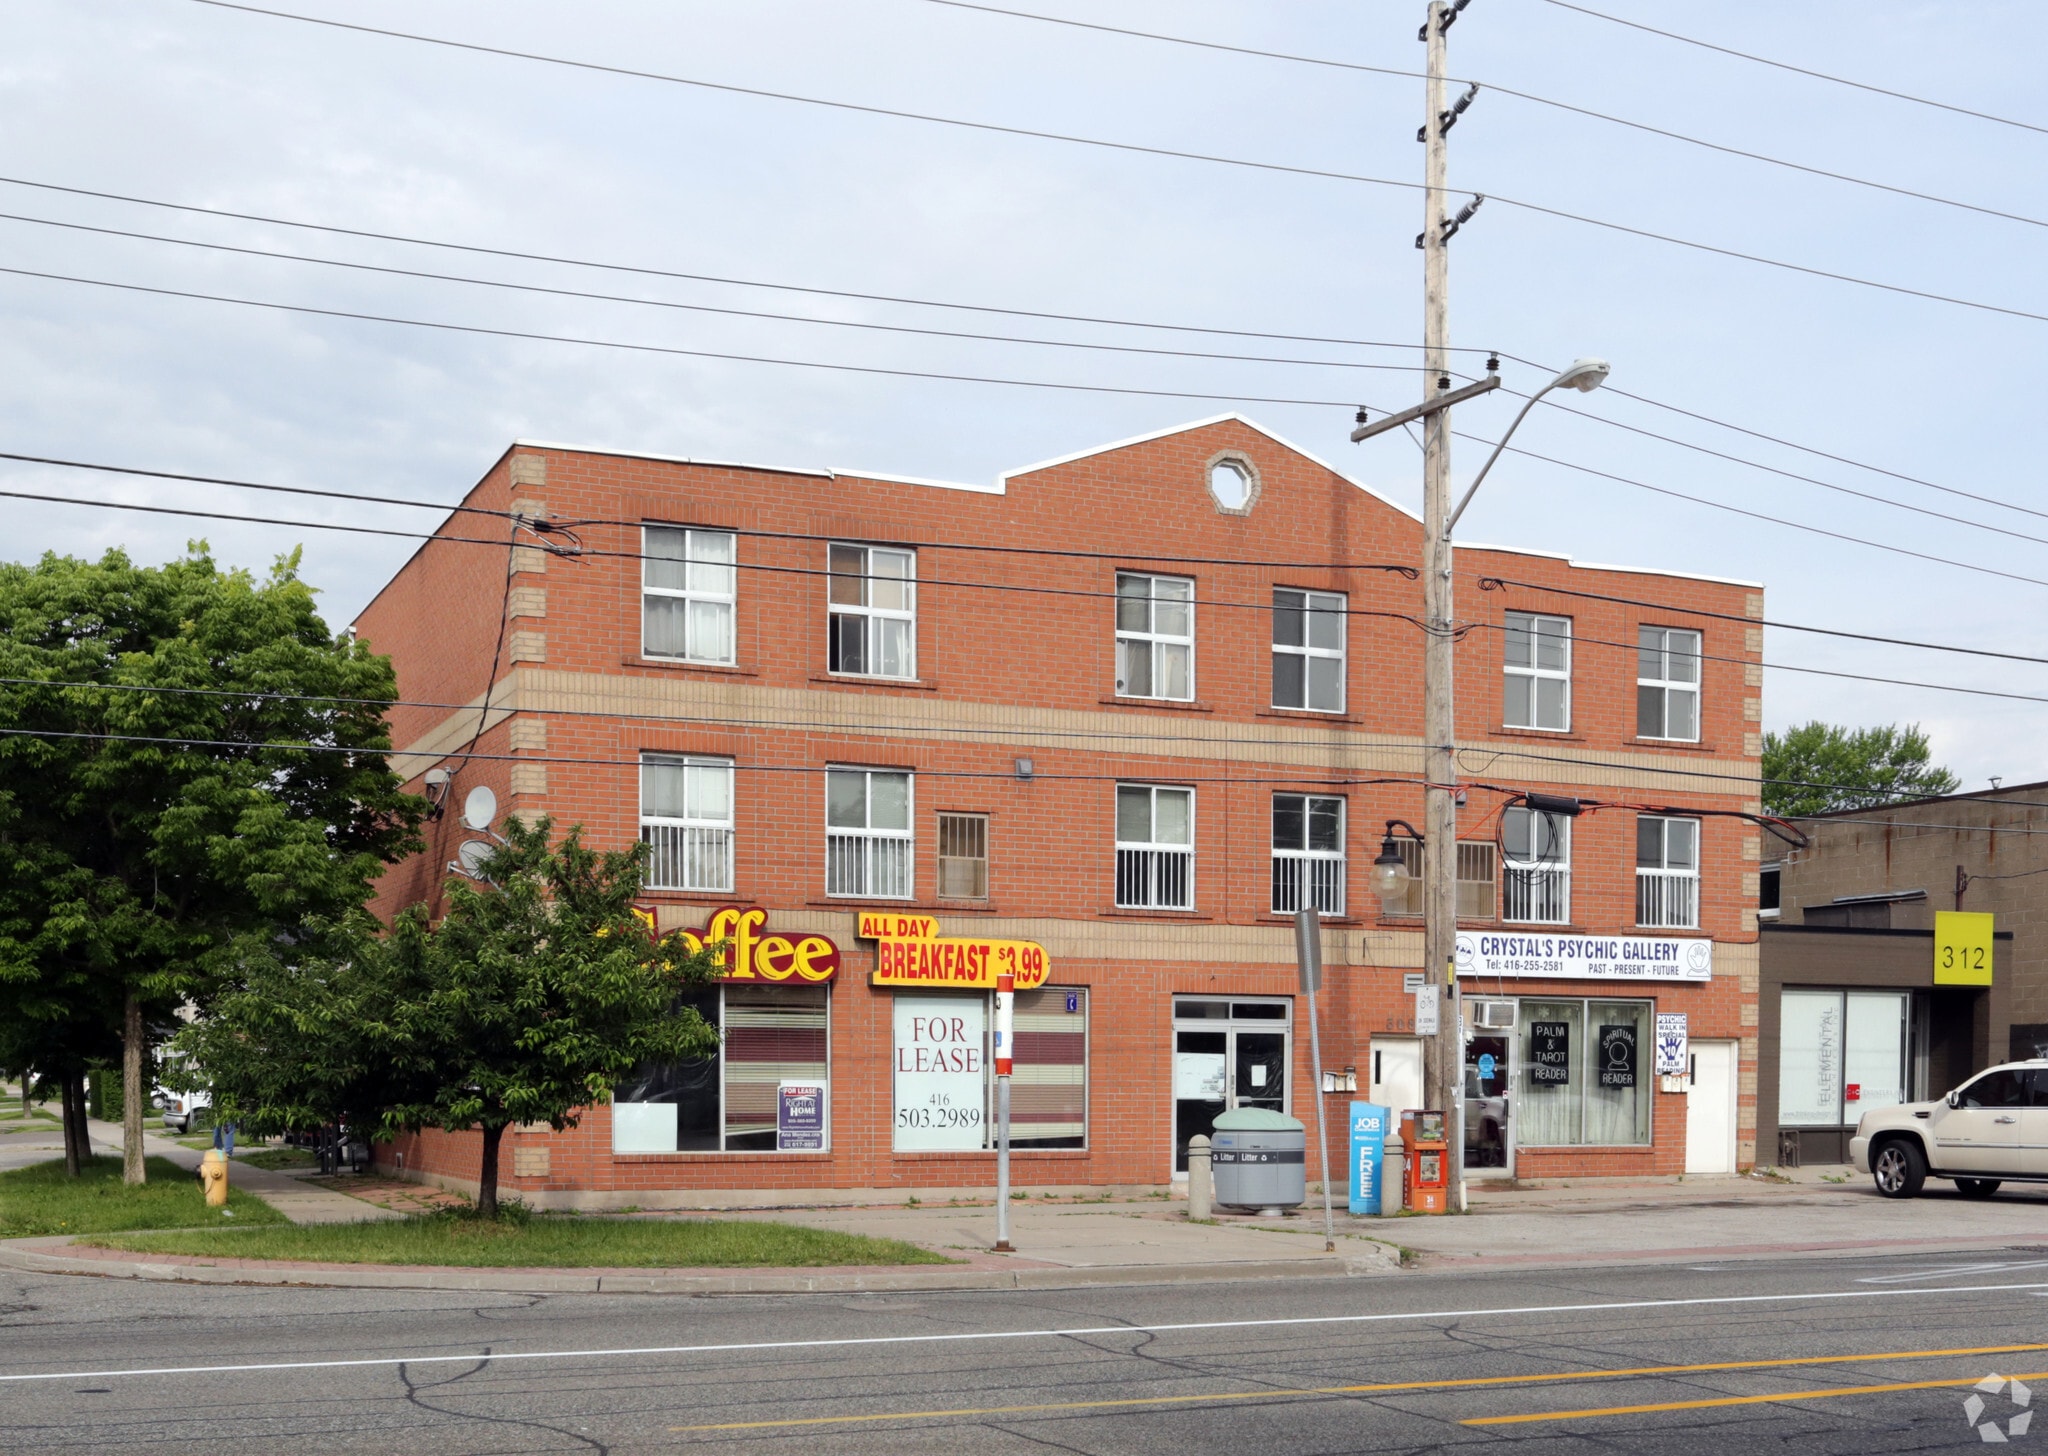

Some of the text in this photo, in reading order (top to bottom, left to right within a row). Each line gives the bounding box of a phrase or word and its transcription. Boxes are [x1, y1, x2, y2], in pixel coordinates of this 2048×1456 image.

[861, 917, 931, 937] ALL DAY
[1481, 936, 1679, 961] CRYSTAL'S PSYCHIC GALLERY
[880, 942, 1043, 983] BREAKFAST $3.99
[1942, 945, 1985, 970] 312
[1486, 959, 1563, 972] Tel: 416-255-2581
[1588, 963, 1607, 974] PAST
[1614, 964, 1645, 976] PRESENT
[1652, 965, 1680, 976] FUTURE
[1657, 1015, 1686, 1023] PSYCHIC
[912, 1016, 967, 1042] FOR
[1536, 1025, 1565, 1037] PALM
[1658, 1031, 1686, 1039] SPECIAL
[1547, 1039, 1554, 1050] &
[1602, 1028, 1635, 1049] SPIRITUAL
[897, 1047, 980, 1073] LEASE
[1536, 1051, 1566, 1063] TAROT
[1819, 1006, 1833, 1103] ELEMENTAL
[1535, 1068, 1566, 1080] READER
[1602, 1073, 1633, 1084] READER
[797, 1087, 816, 1095] LEASE
[929, 1092, 950, 1106] 416
[790, 1107, 816, 1117] HOME
[897, 1108, 981, 1129] 503.2989
[1355, 1117, 1380, 1129] JOB
[1220, 1152, 1235, 1161] Litter
[1241, 1152, 1258, 1161] Litter
[1360, 1146, 1374, 1198] FREE
